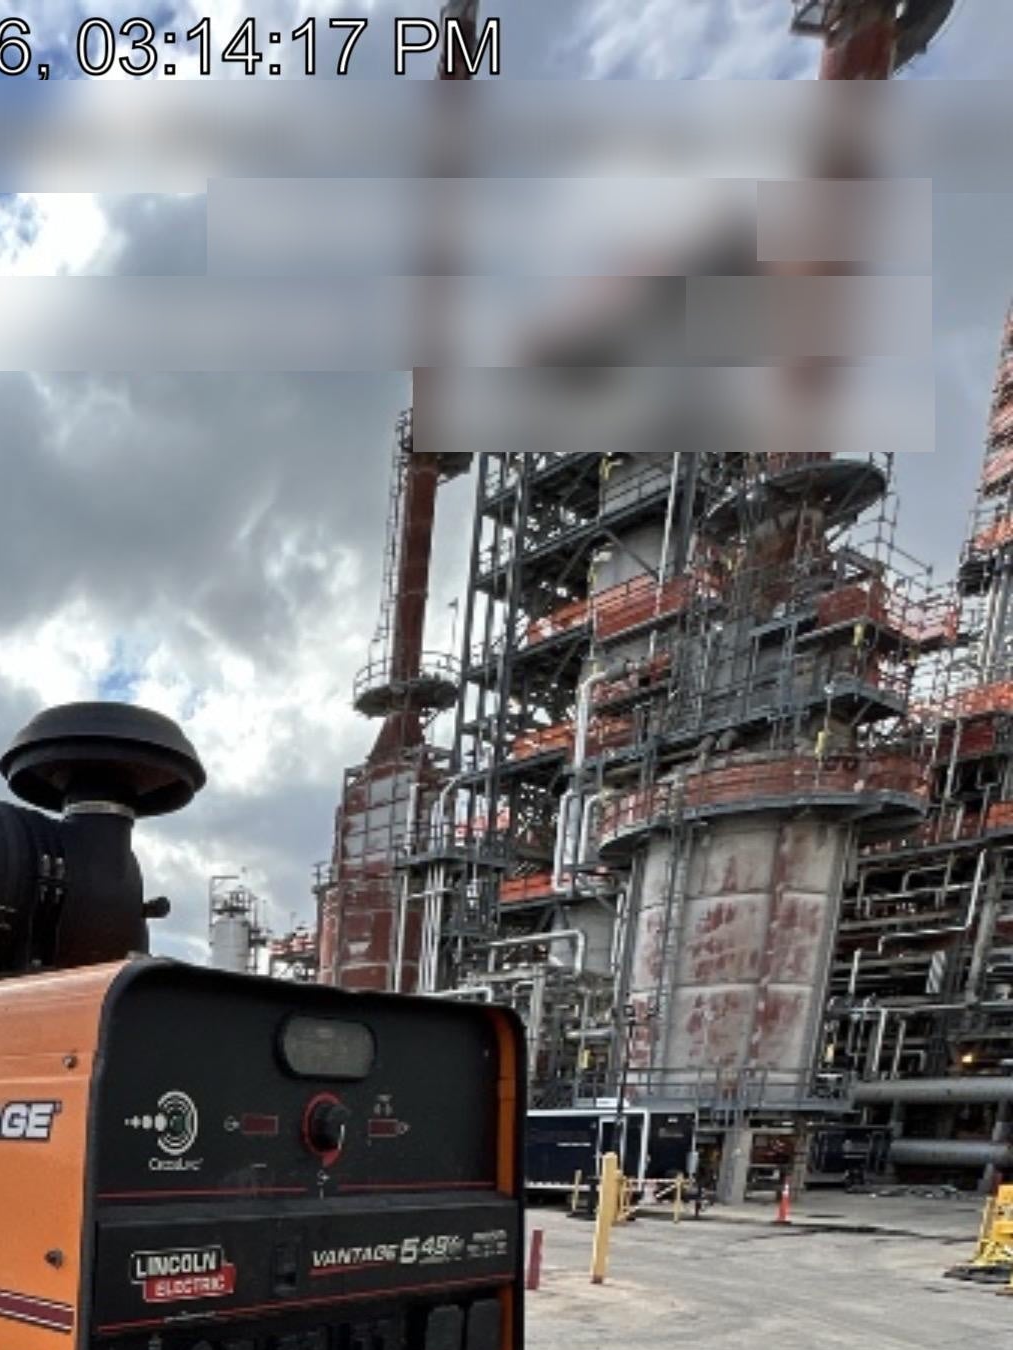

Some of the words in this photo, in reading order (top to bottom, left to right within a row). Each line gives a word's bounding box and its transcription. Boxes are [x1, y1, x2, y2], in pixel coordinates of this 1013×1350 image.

[136, 1251, 217, 1278] LINCOLN
[312, 1243, 399, 1267] VANTAGE
[155, 1275, 225, 1297] ELECTRIC
